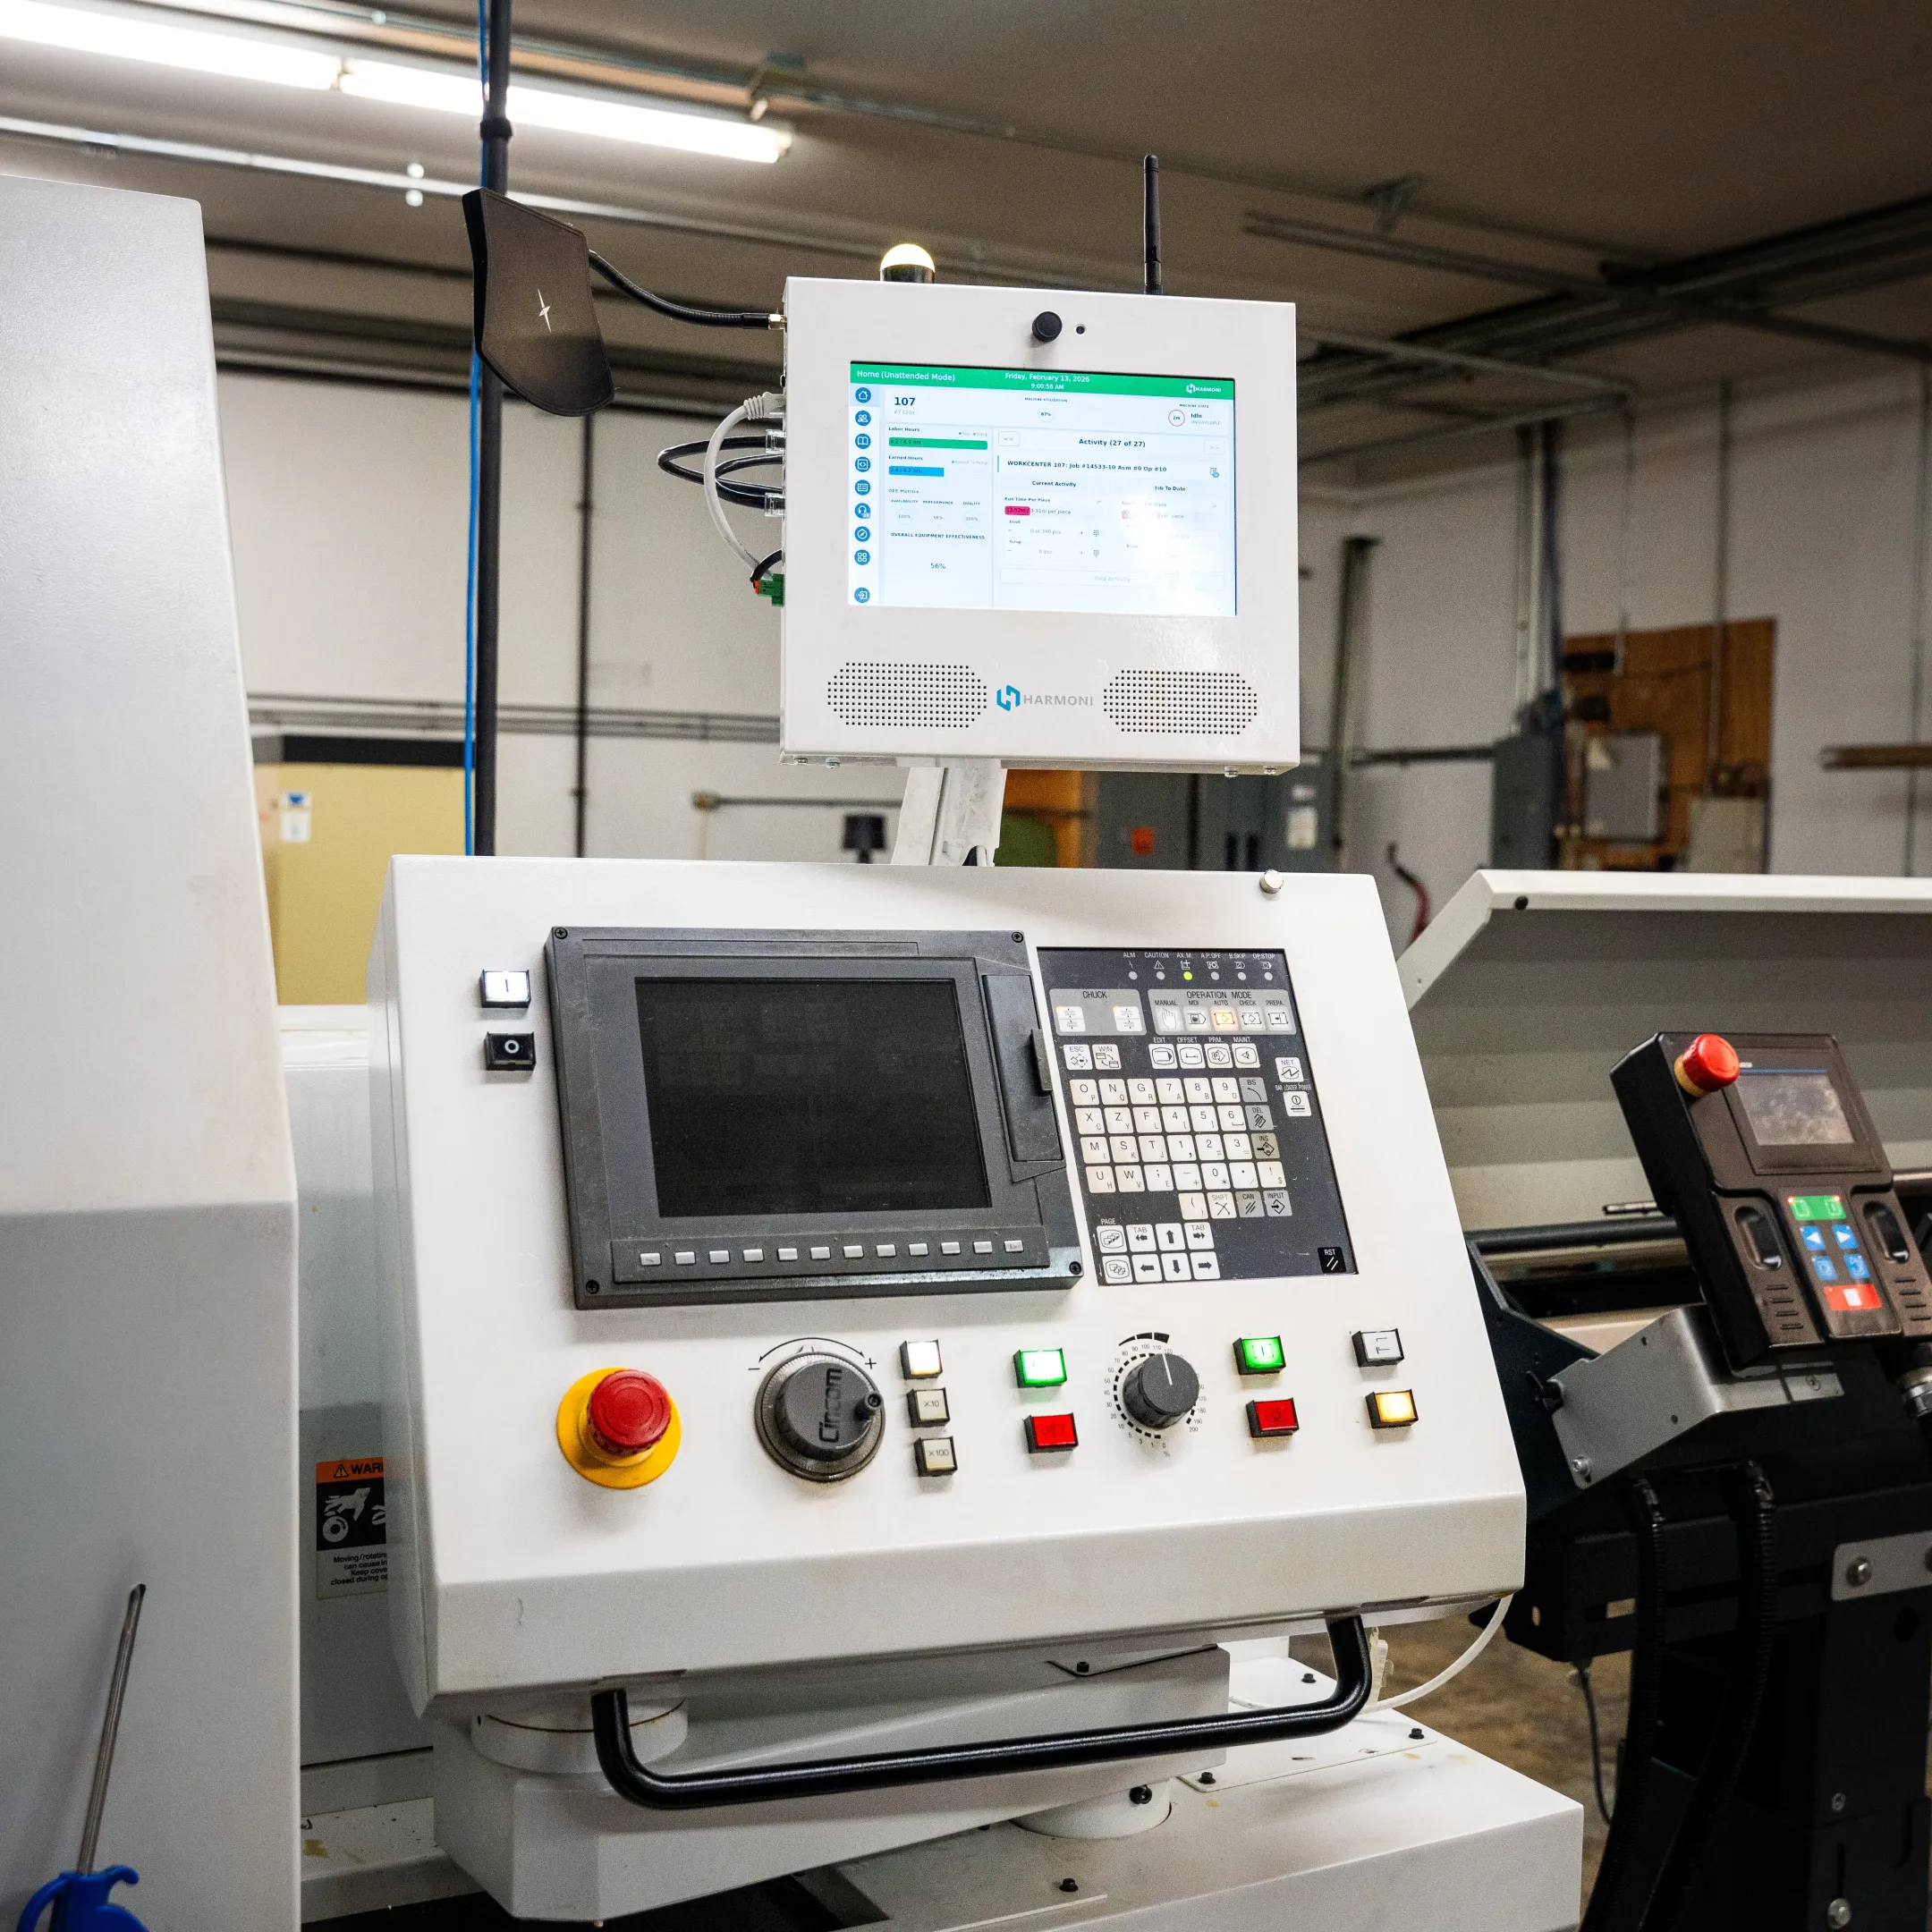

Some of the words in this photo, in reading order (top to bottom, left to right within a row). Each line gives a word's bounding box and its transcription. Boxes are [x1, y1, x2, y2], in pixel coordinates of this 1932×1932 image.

[857, 370, 880, 378] Home
[881, 371, 929, 380] (Unattended
[931, 373, 955, 382] Mode)
[1004, 372, 1028, 381] Friday,
[1030, 373, 1059, 382] February
[894, 396, 916, 406] 107
[1078, 438, 1107, 447] Activity
[1023, 694, 1094, 706] HARMONI
[1082, 990, 1107, 998] CHUCK
[1186, 991, 1227, 999] OPERATION
[1231, 991, 1252, 999] MODE
[1108, 1083, 1117, 1092] N
[1137, 1083, 1146, 1092] G
[1165, 1083, 1173, 1091] 7
[1194, 1082, 1201, 1091] 8
[1222, 1082, 1229, 1091] 9
[1085, 1113, 1094, 1122] X
[1114, 1113, 1123, 1121] Z
[1143, 1112, 1150, 1120] F
[1172, 1111, 1178, 1120] 4
[1200, 1111, 1207, 1120] 5
[1228, 1110, 1235, 1119] 6
[1089, 1141, 1100, 1151] M
[1120, 1141, 1128, 1150] S
[1148, 1140, 1156, 1149] T
[1206, 1140, 1213, 1148] 2
[1233, 1139, 1241, 1148] 3
[1096, 1171, 1105, 1181] U
[1123, 1170, 1135, 1180] W
[333, 1552, 387, 1563] Moving/rotatin
[359, 1561, 380, 1569] cause
[330, 1576, 354, 1586] closed
[356, 1574, 379, 1582] during
